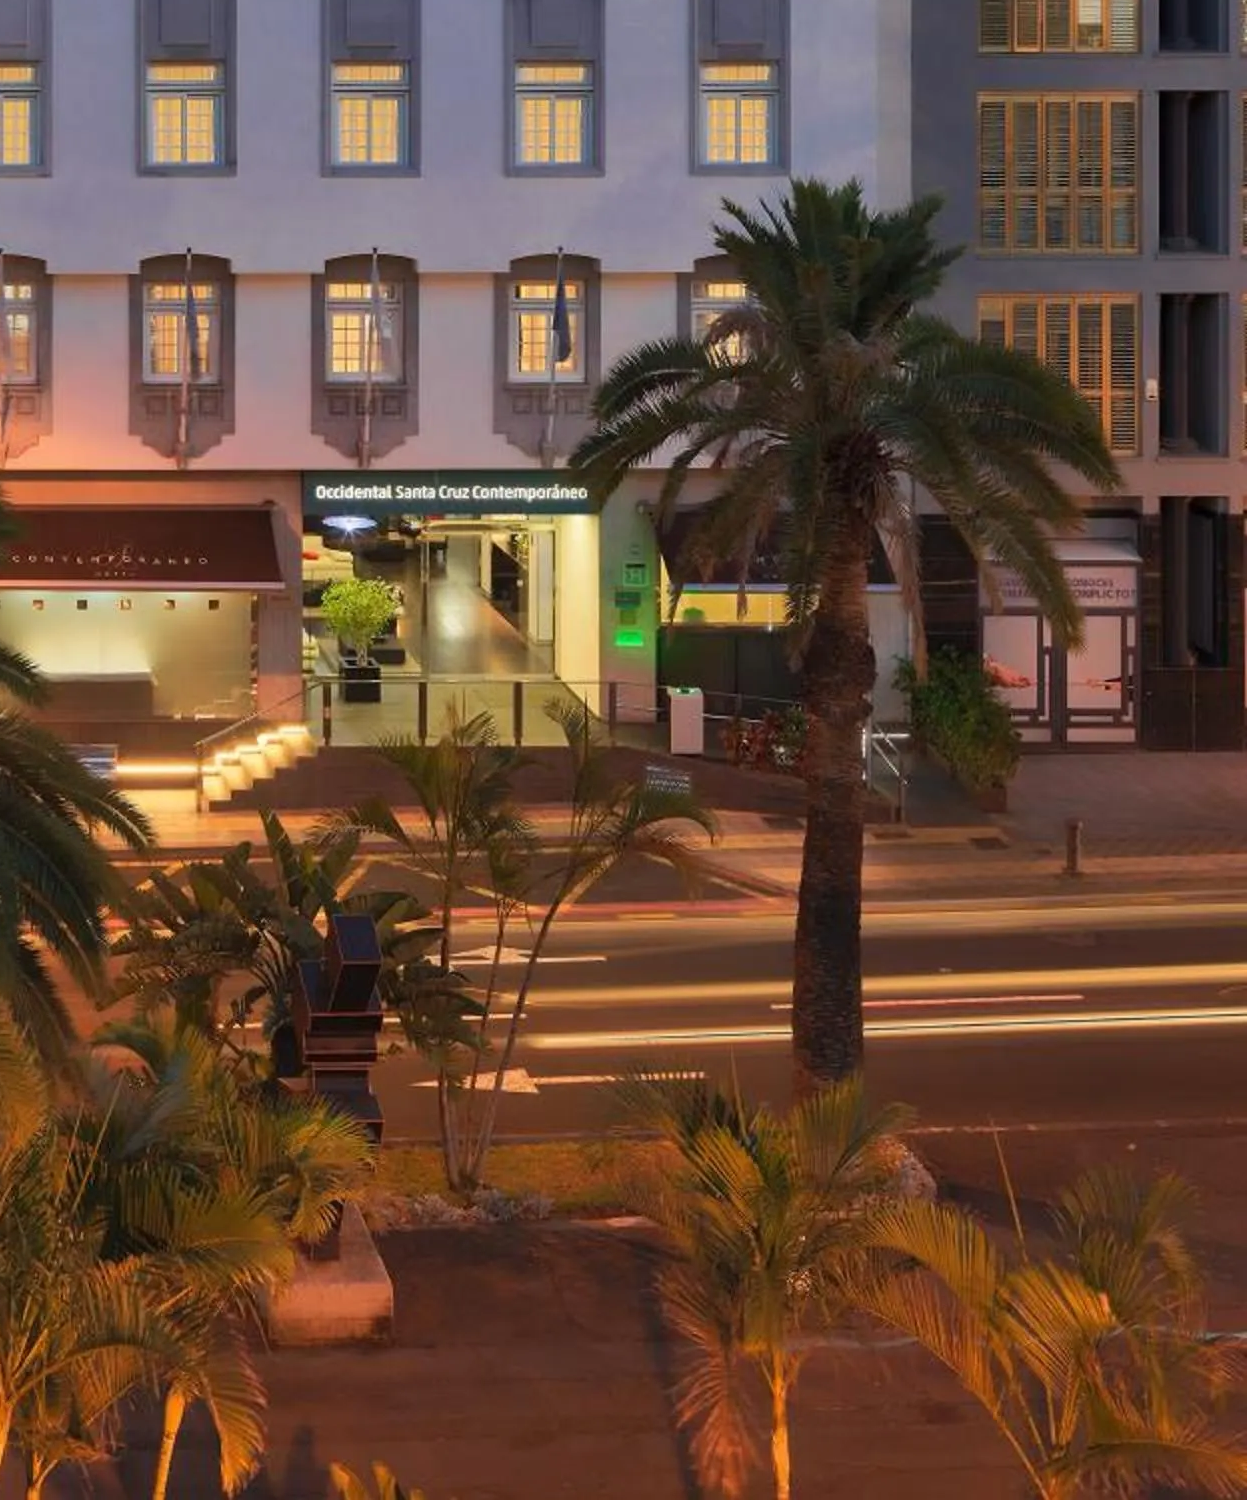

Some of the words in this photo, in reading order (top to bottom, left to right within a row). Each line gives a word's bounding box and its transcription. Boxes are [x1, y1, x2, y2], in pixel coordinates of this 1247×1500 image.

[315, 484, 391, 499] Occidental
[396, 485, 435, 499] Santa
[439, 485, 470, 499] Cruz
[472, 485, 588, 502] Contemporáneo
